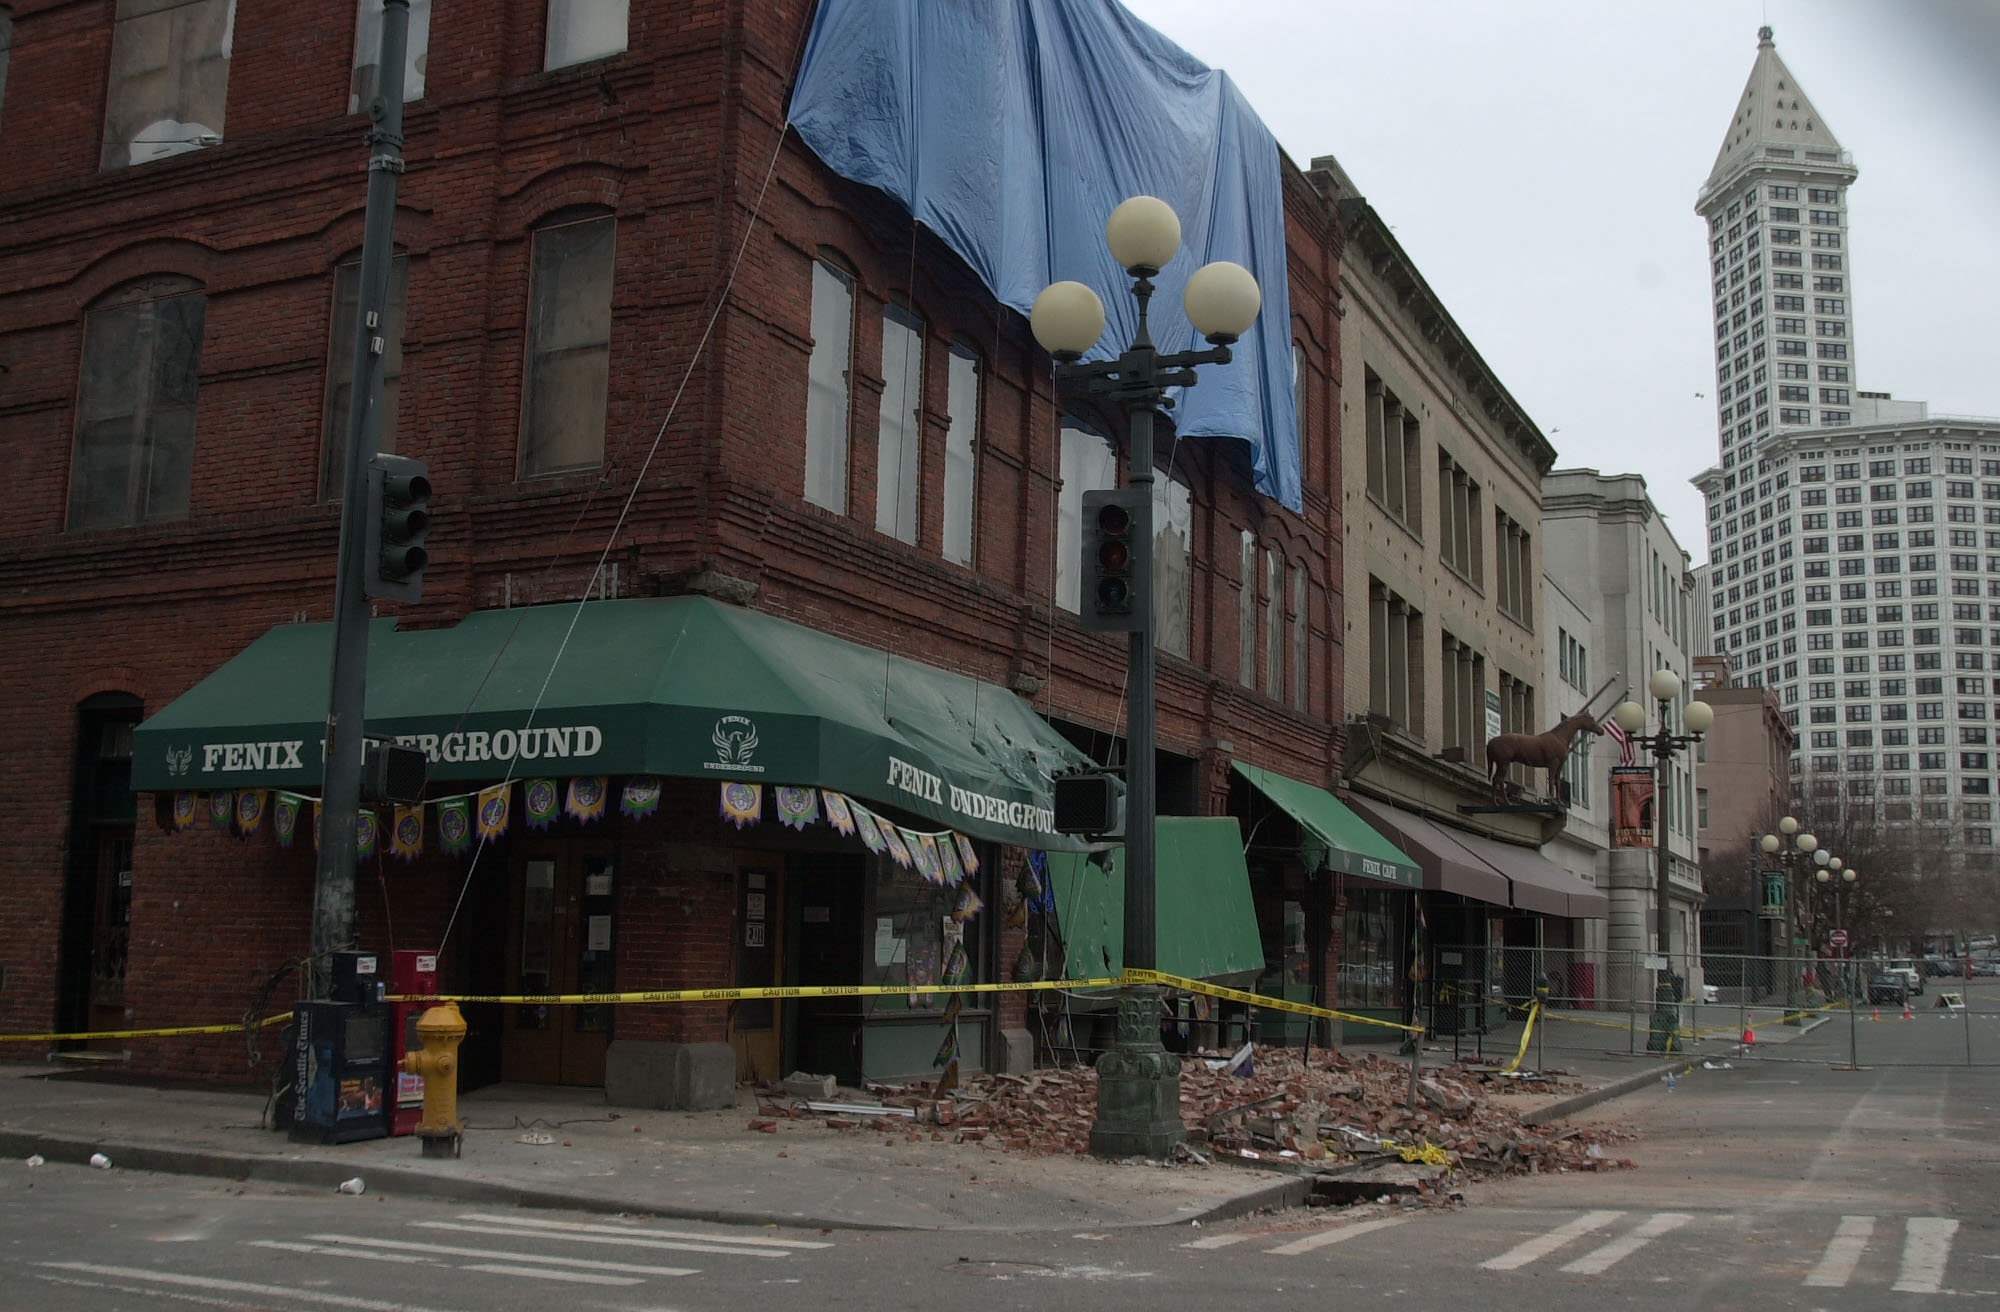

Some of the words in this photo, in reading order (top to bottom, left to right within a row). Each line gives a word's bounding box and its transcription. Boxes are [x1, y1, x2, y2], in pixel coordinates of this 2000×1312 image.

[202, 740, 303, 773] FENIX
[320, 725, 603, 767] RGROUND
[887, 756, 943, 805] FENIX
[949, 783, 1058, 835] UNDERGROU
[1363, 858, 1381, 876] FENIX
[1382, 863, 1397, 879] CAFE
[522, 993, 560, 1003] CAUTION
[582, 993, 621, 1003] CAUTION
[642, 991, 681, 1001] CAUTION
[702, 989, 741, 999] CAUTION
[762, 987, 800, 997] CAUTION
[821, 986, 859, 995] CAUTION
[880, 984, 917, 993] CAUTION
[1127, 969, 1157, 980] CAUTION
[297, 1010, 310, 1052] Times
[295, 1052, 309, 1096] Seattle
[293, 1096, 306, 1121] The
